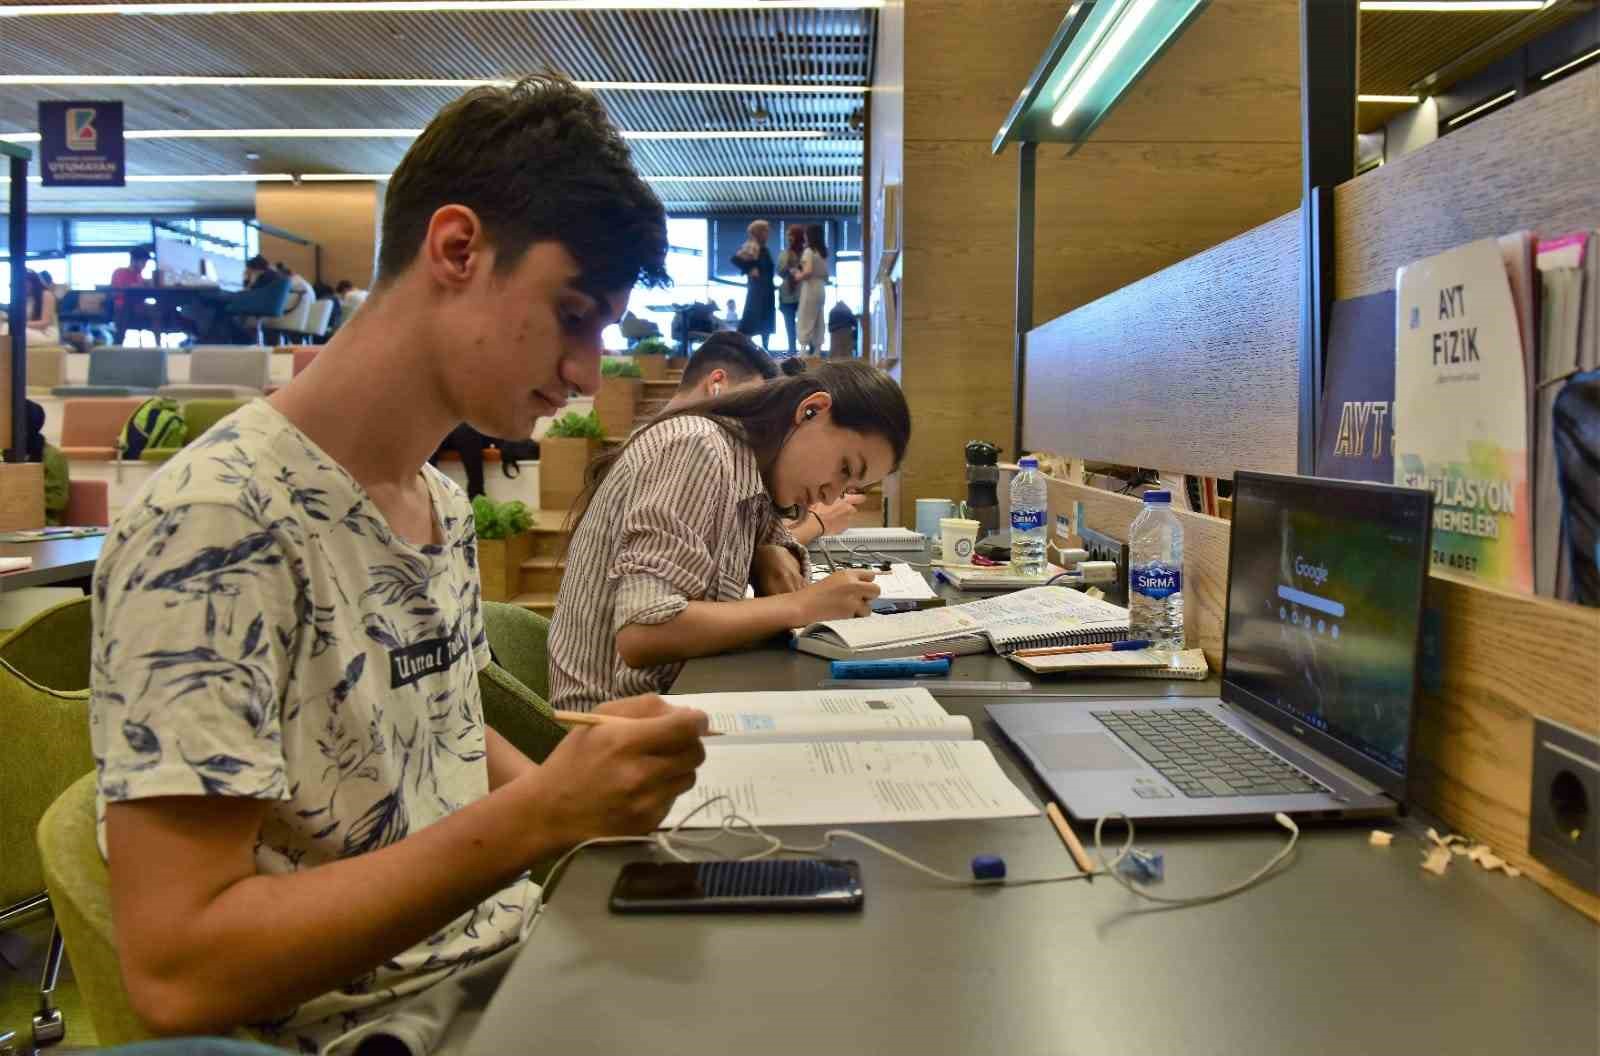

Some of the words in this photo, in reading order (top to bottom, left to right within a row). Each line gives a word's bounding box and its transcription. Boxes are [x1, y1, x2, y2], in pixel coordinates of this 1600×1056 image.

[1438, 284, 1465, 320] AYT
[1333, 401, 1388, 458] AYT
[1138, 575, 1175, 589] SIRMA
[1295, 555, 1328, 585] Google
